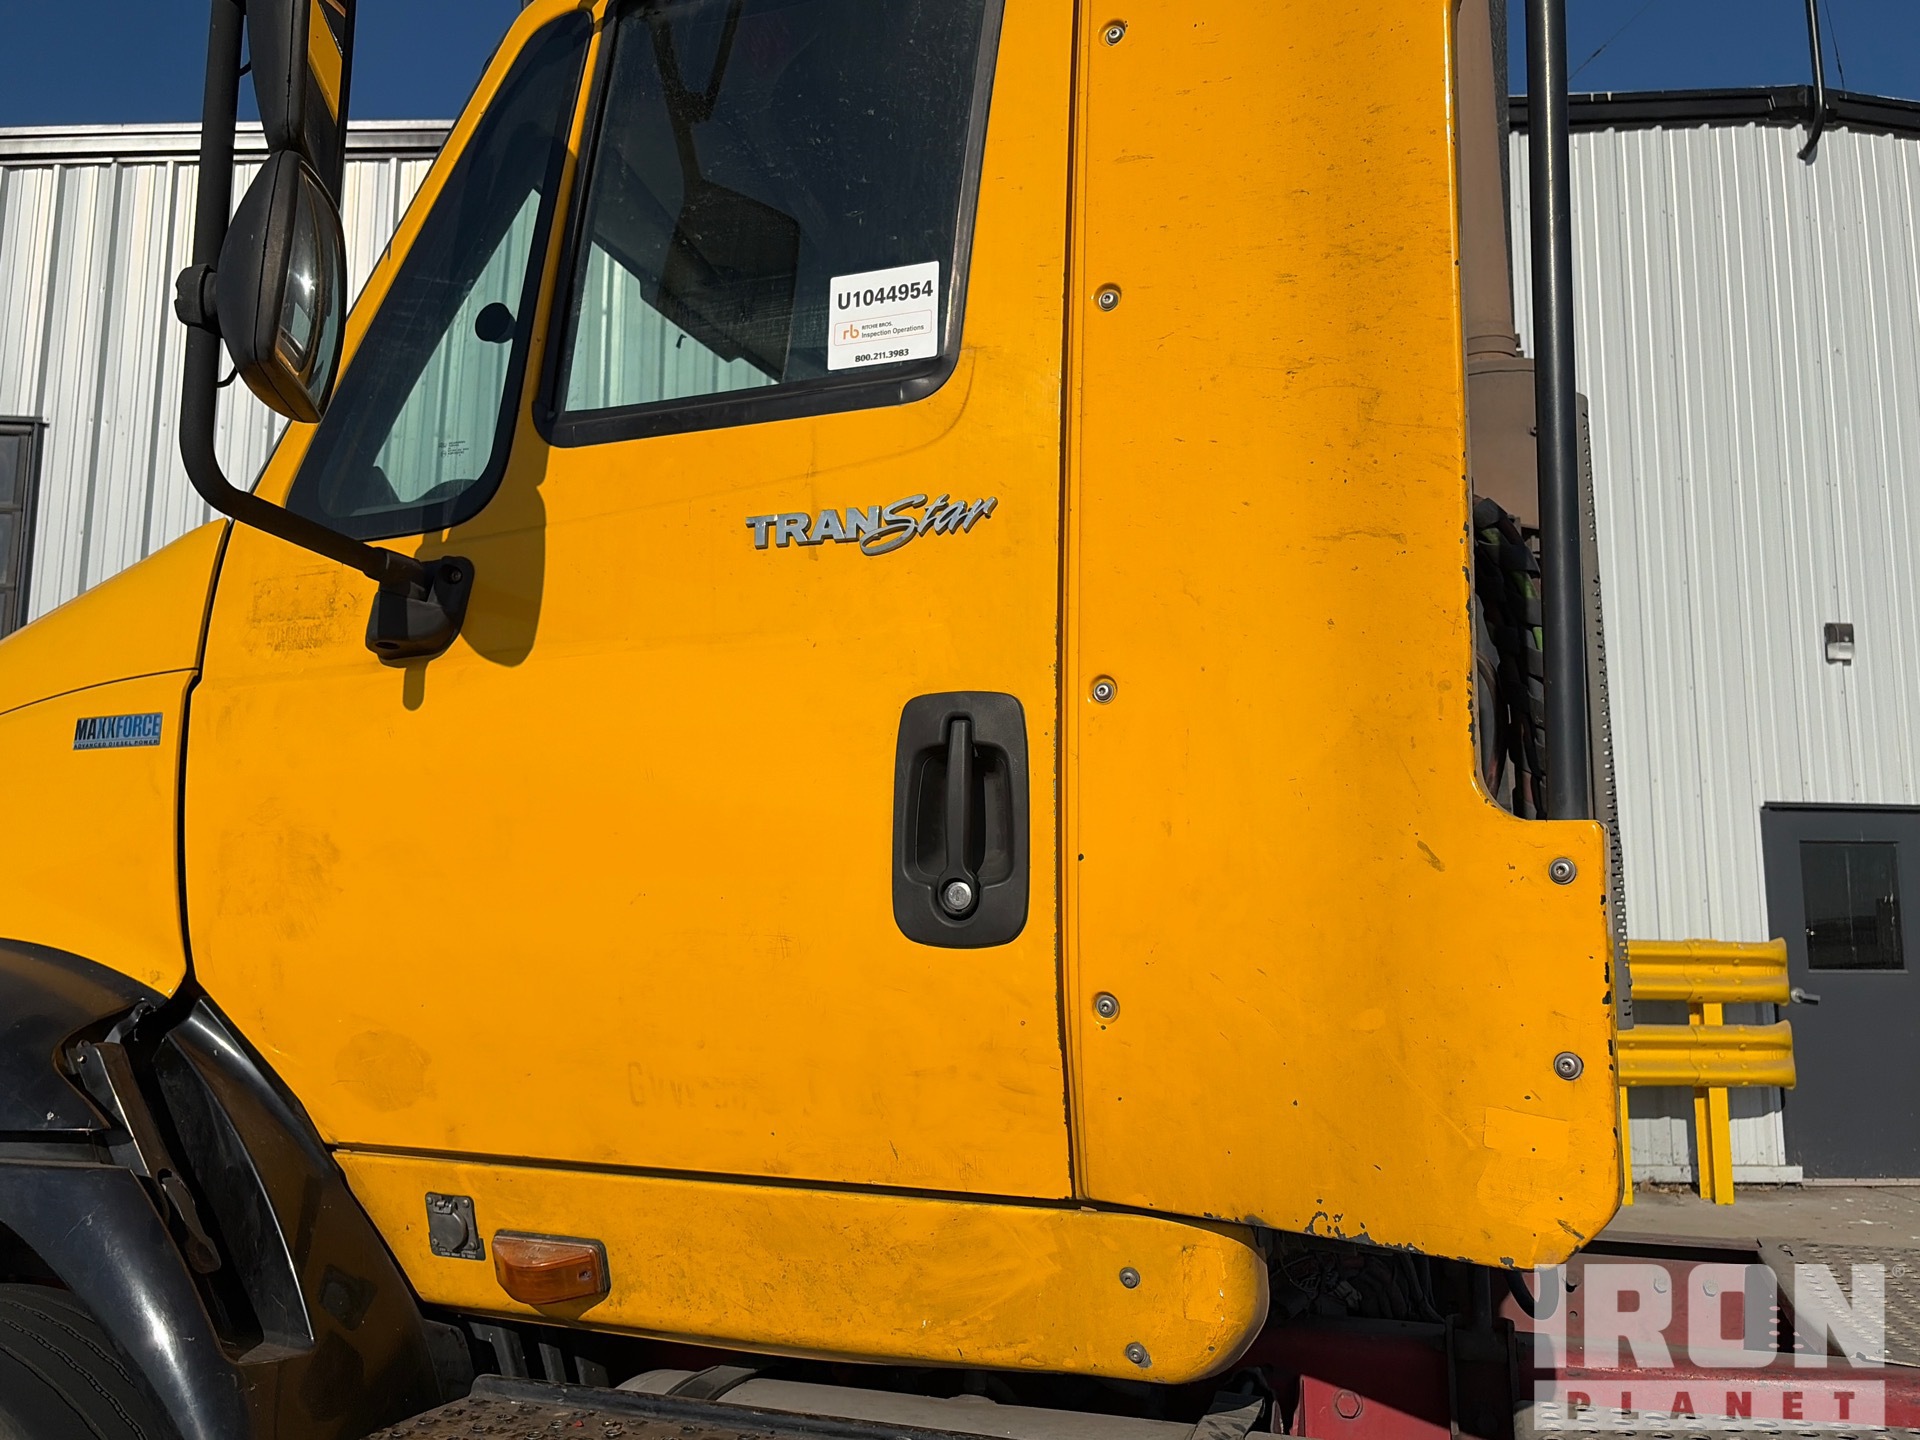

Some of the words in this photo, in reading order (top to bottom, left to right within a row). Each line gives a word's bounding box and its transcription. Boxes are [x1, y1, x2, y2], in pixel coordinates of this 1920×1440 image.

[838, 280, 933, 310] U1044954
[843, 324, 860, 340] rb
[861, 328, 891, 339] Inspection
[892, 325, 924, 336] Operations
[855, 348, 909, 363] 800.211.3983
[74, 713, 162, 741] MAXXFORCE
[74, 741, 107, 749] ADVANCED
